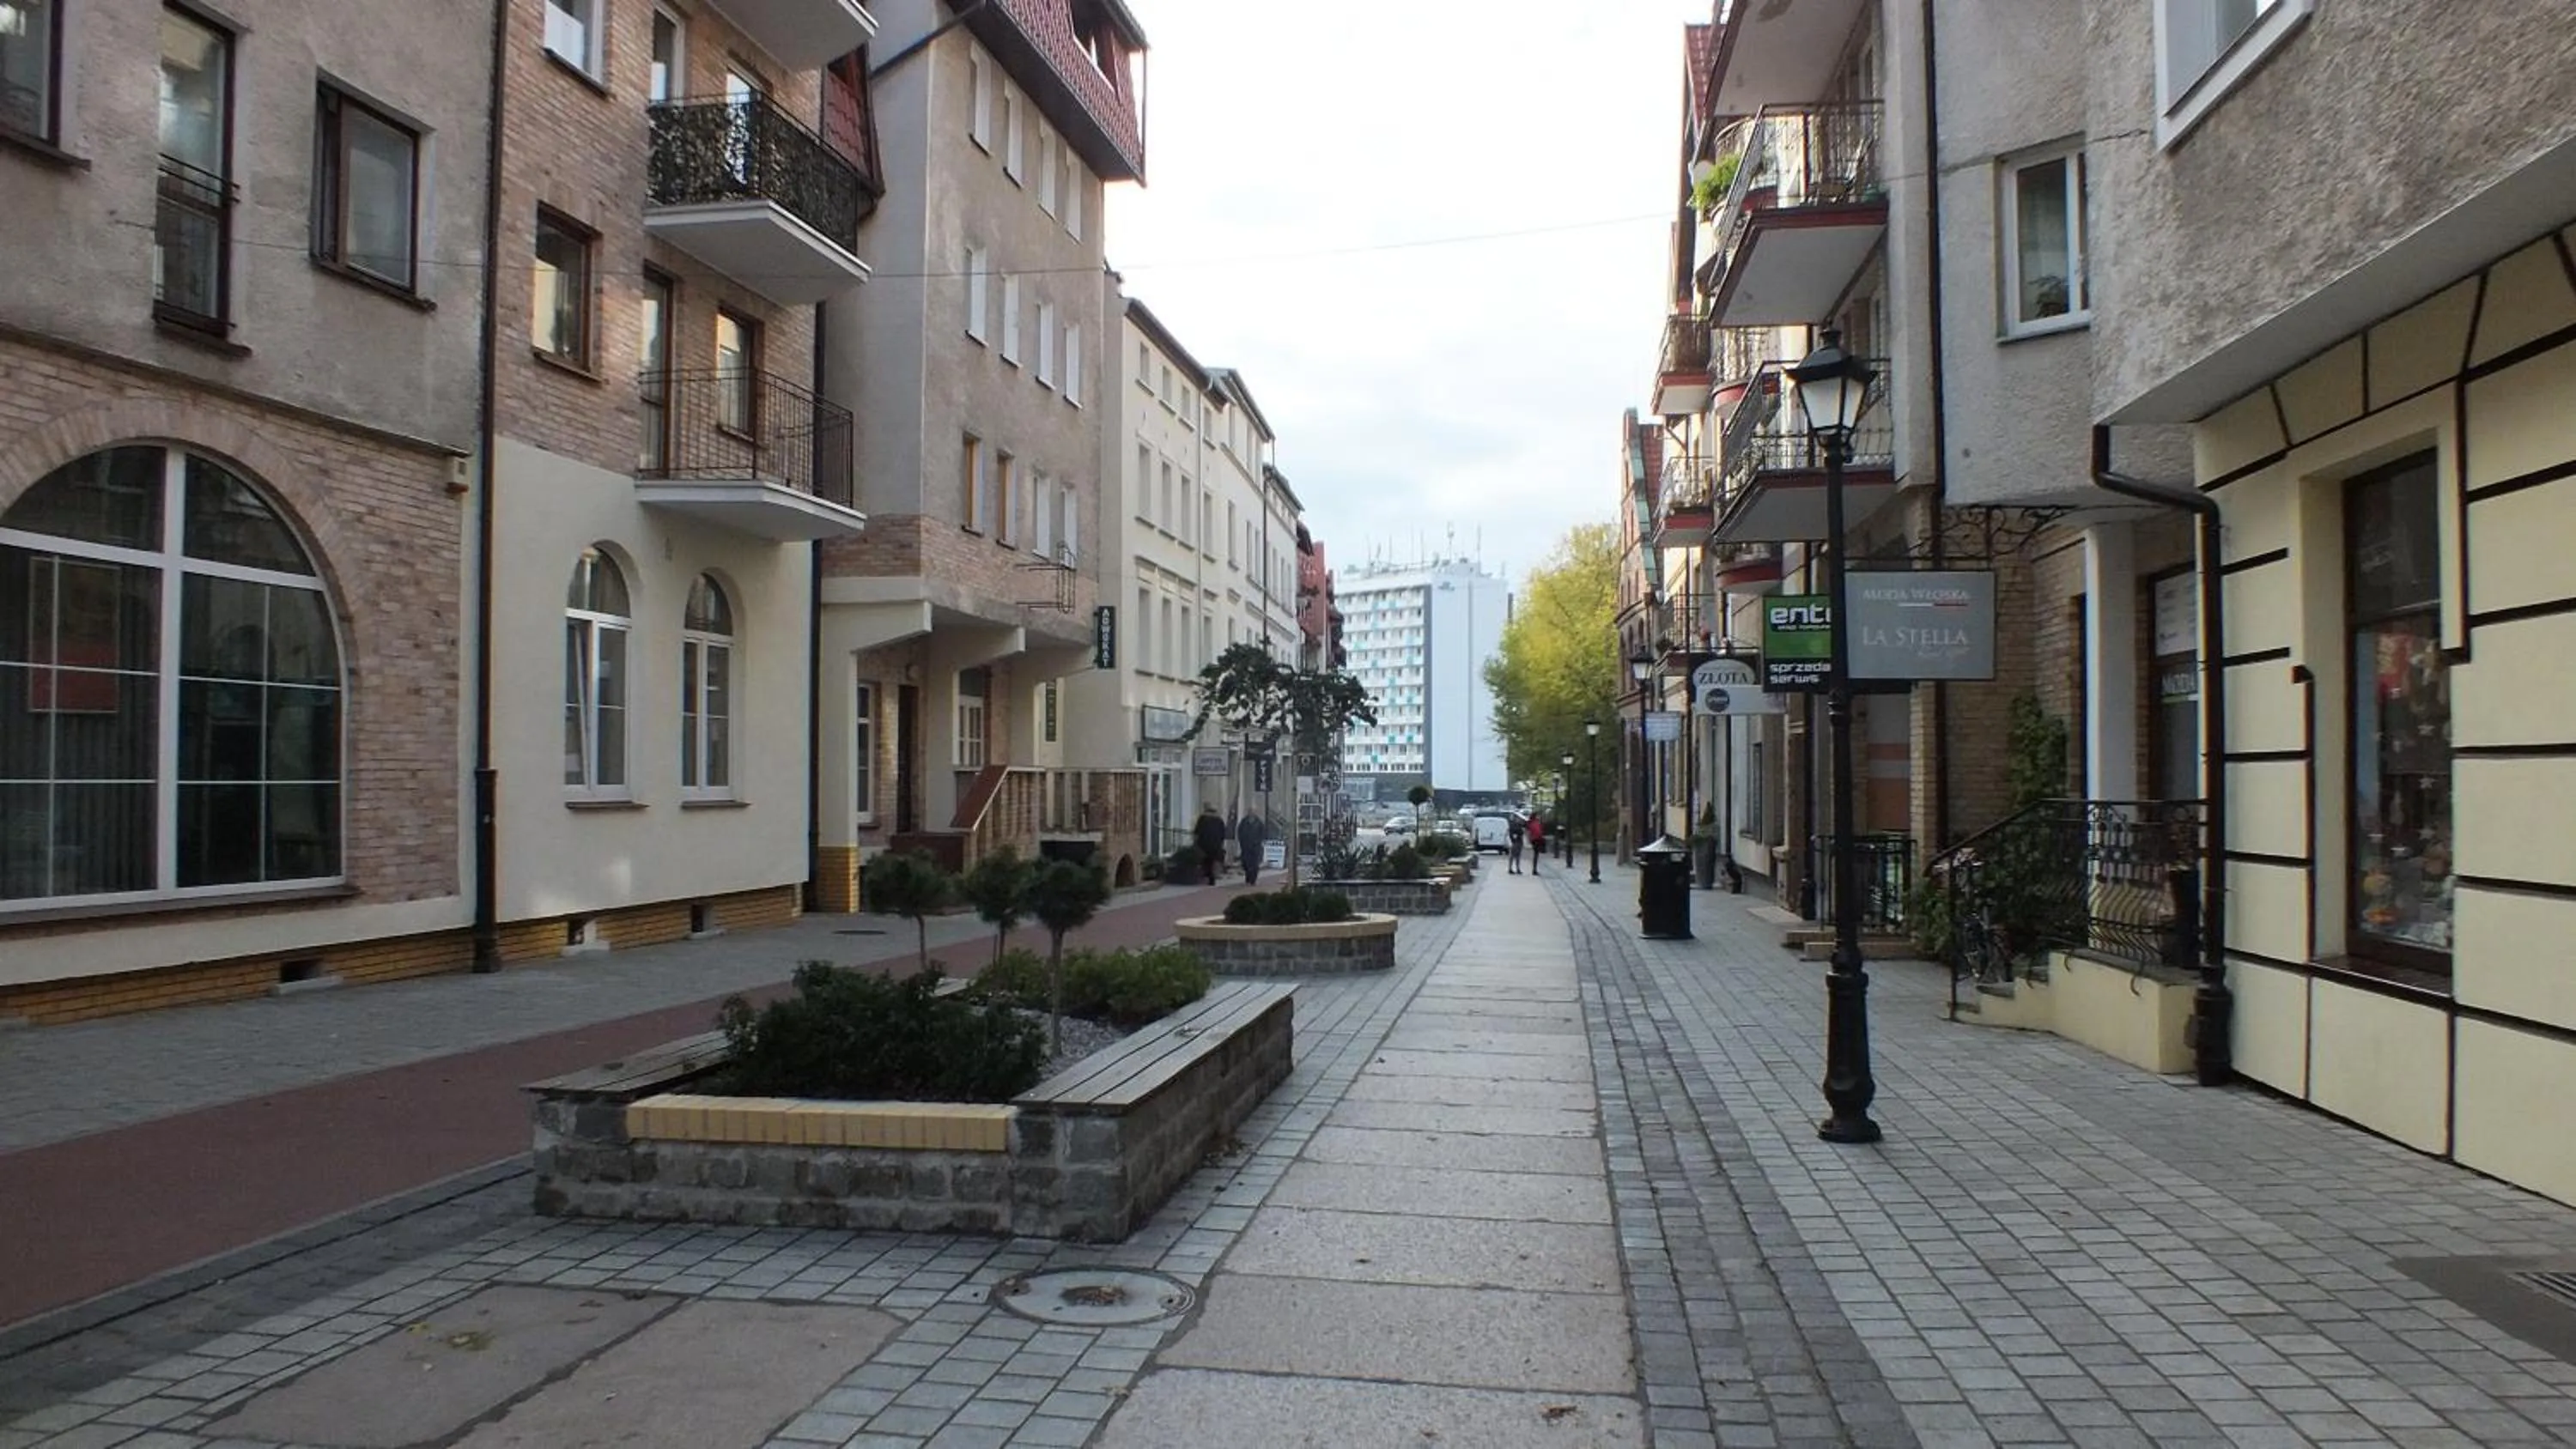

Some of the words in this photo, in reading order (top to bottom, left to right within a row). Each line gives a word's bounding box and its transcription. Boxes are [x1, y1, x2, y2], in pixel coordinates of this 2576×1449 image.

[1102, 608, 1111, 667] ADWOKAT
[1862, 626, 1887, 645] LA
[1895, 627, 1969, 645] STELLA
[1770, 662, 1832, 673] sprzeda
